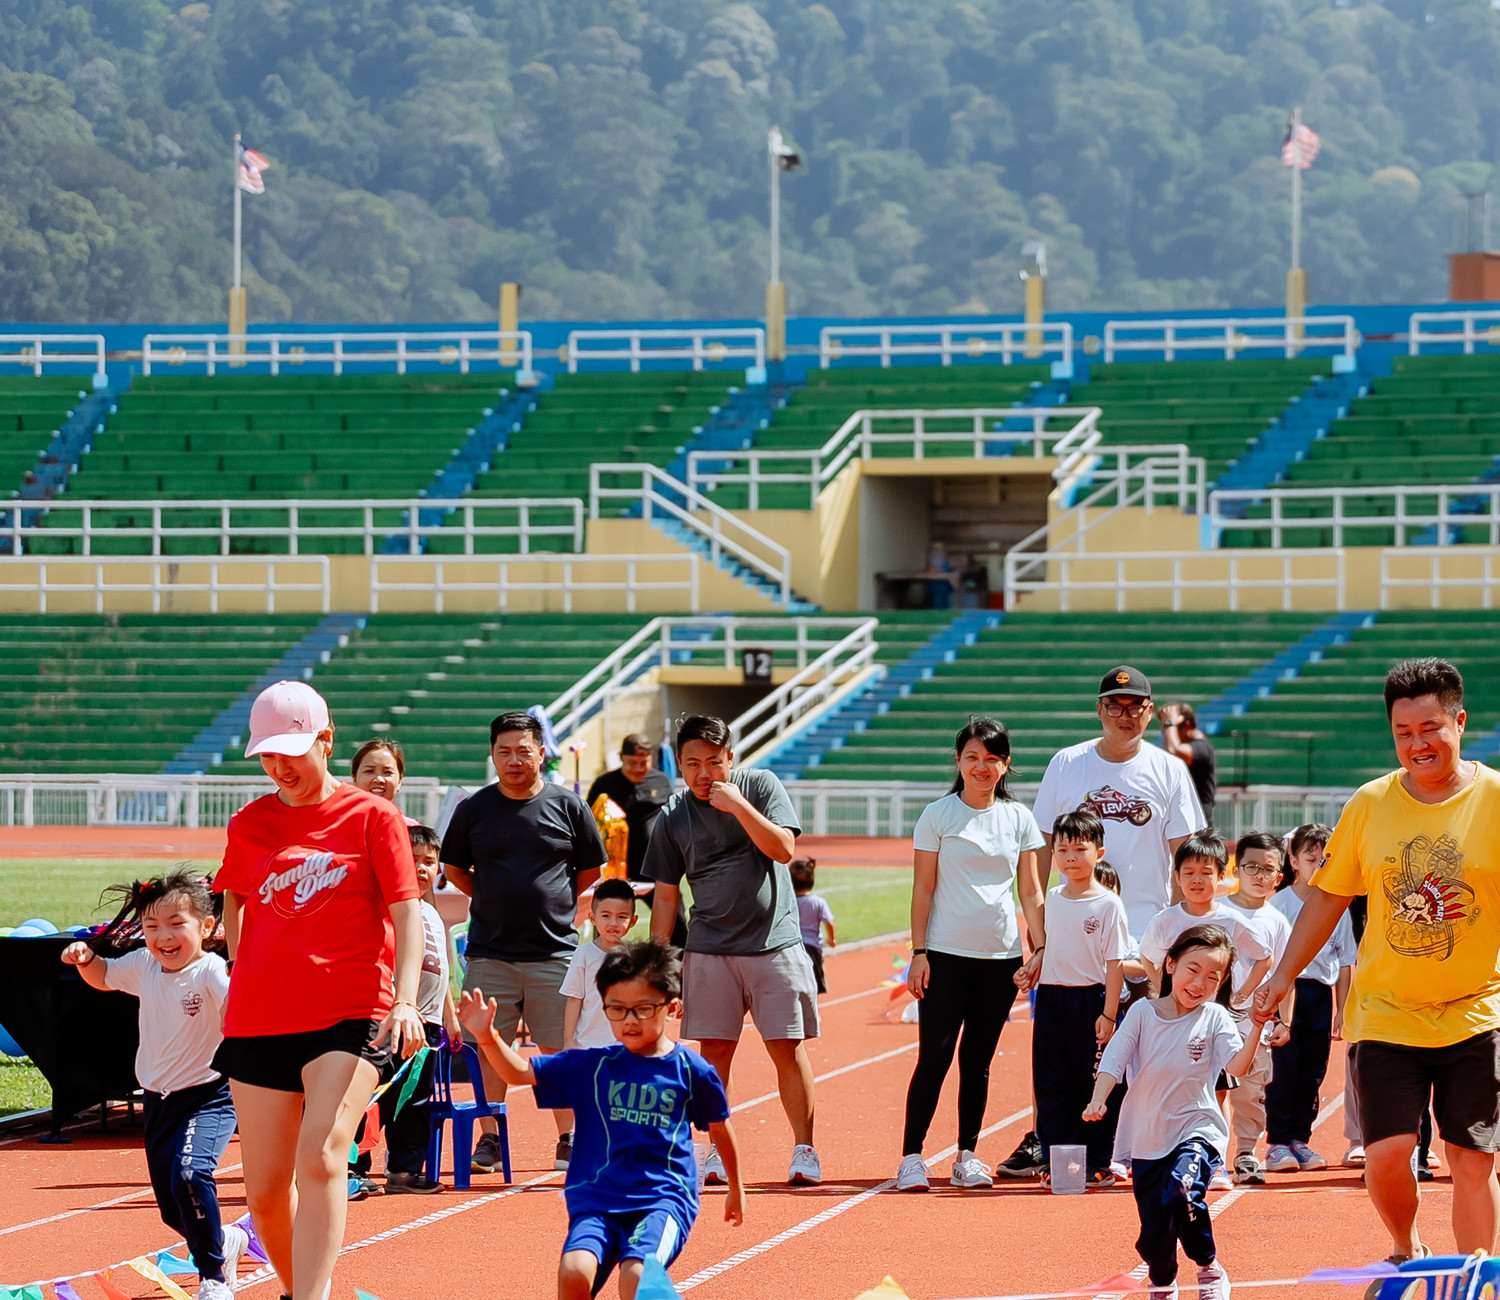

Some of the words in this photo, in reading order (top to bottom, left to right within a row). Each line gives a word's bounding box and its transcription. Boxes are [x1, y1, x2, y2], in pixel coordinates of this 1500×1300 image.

[744, 653, 770, 676] 12
[258, 851, 334, 905] Family
[294, 864, 349, 904] Day
[1423, 880, 1442, 900] SUMO
[608, 1080, 677, 1114] KIDS
[609, 1107, 671, 1129] SPORTS
